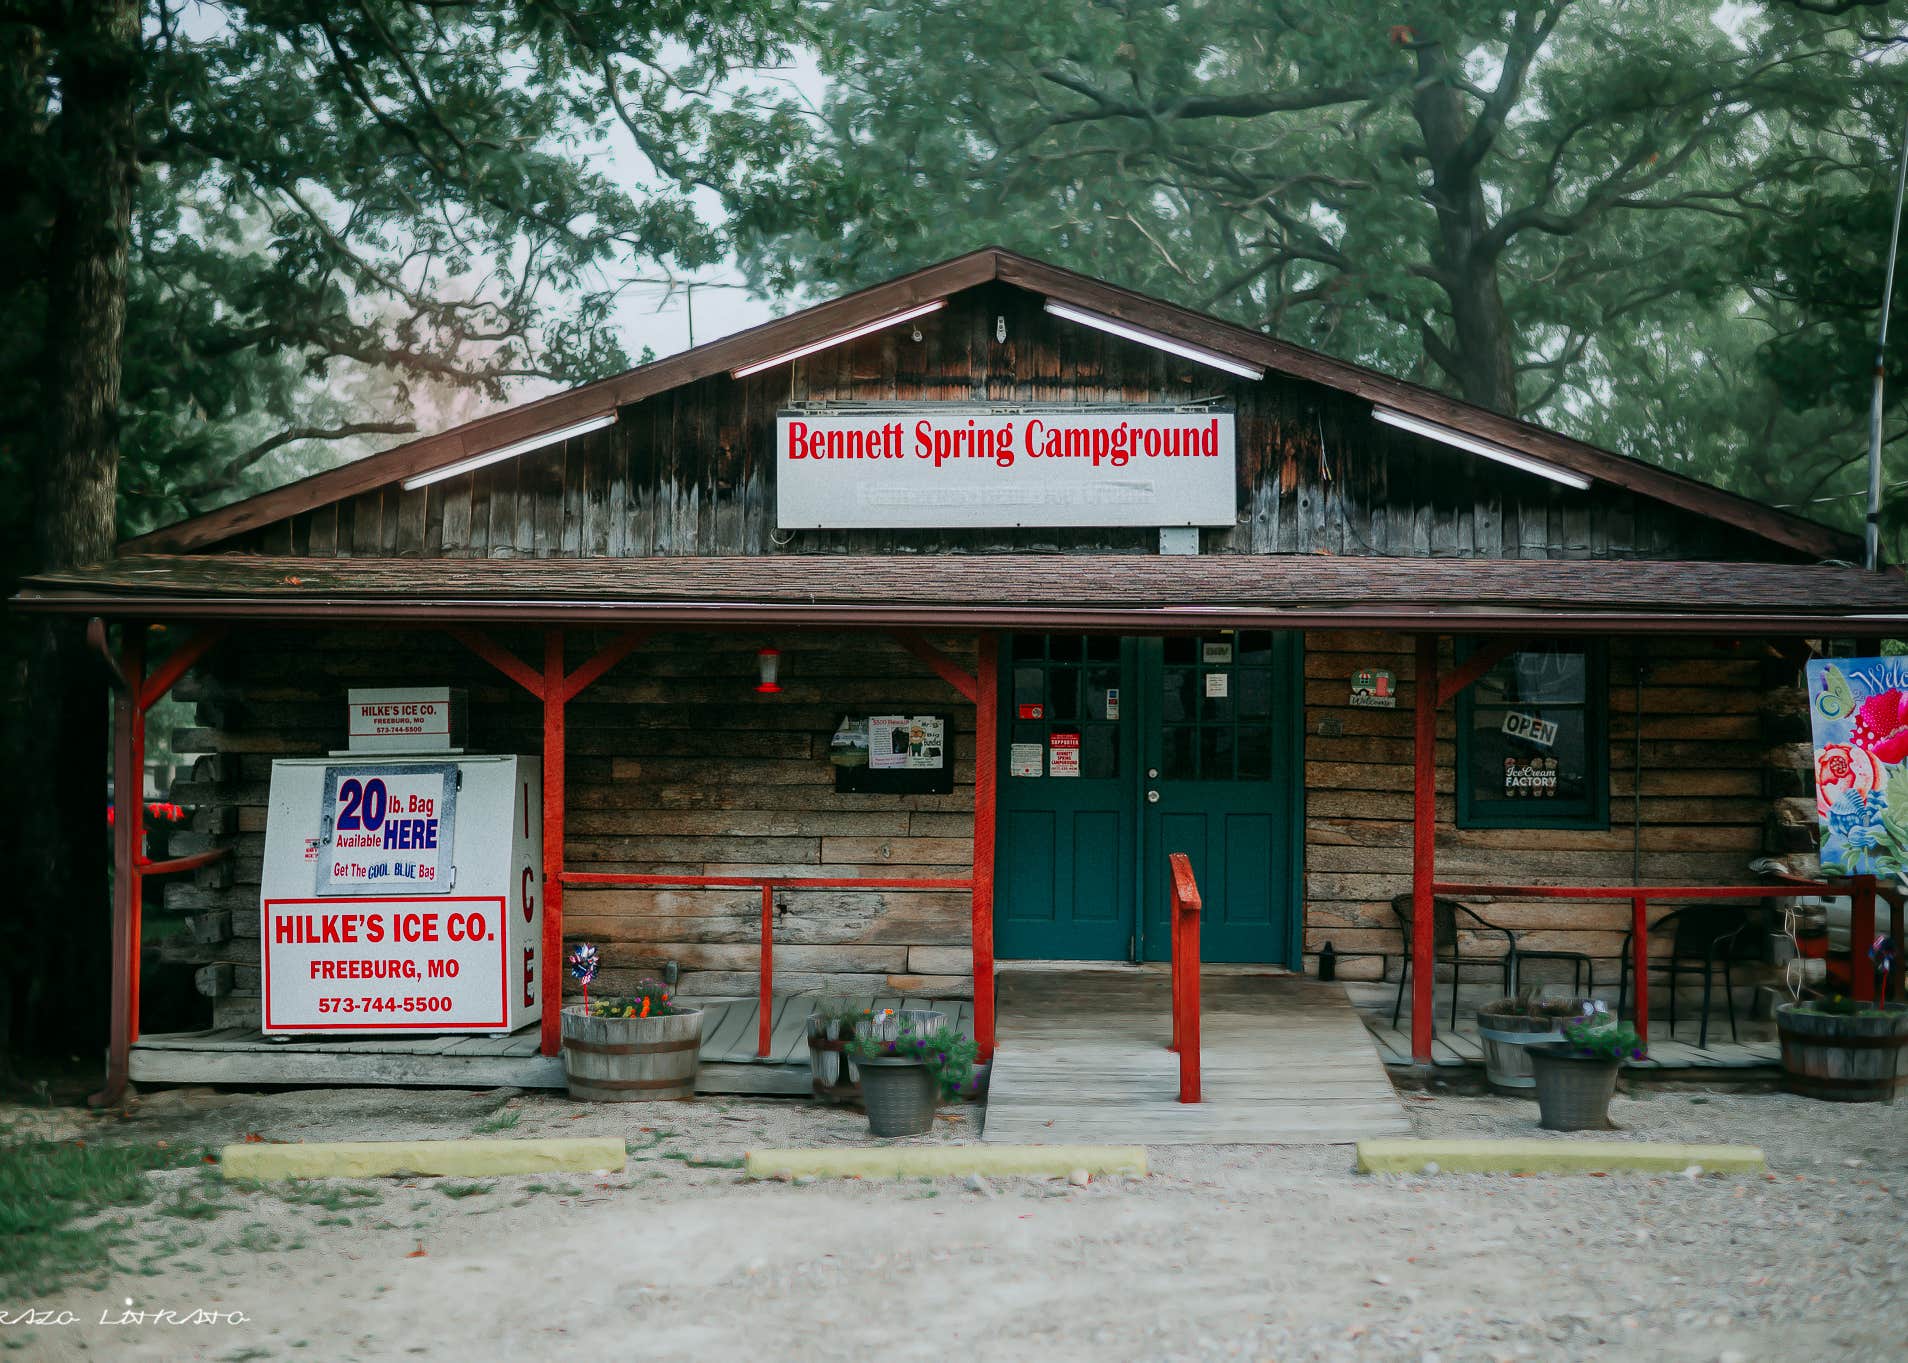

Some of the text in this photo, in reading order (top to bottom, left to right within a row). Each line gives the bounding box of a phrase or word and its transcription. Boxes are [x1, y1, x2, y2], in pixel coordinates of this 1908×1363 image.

[788, 418, 1219, 468] Bennett Spring Campground
[361, 705, 437, 717] HILKE'S ICE CO.
[1506, 714, 1555, 743] OPEN
[1505, 766, 1556, 777] Ice Cream
[1505, 776, 1557, 787] FACTORY
[336, 777, 434, 831] 20 lb. Bag
[336, 818, 439, 850] Available HERE
[334, 862, 435, 880] Get The COOL BLUE Bag
[522, 782, 535, 1008] ICE
[275, 912, 495, 944] HILKE'S ICE CO.
[310, 958, 460, 982] FREEBURG, MO
[318, 996, 453, 1013] 573-744-5500
